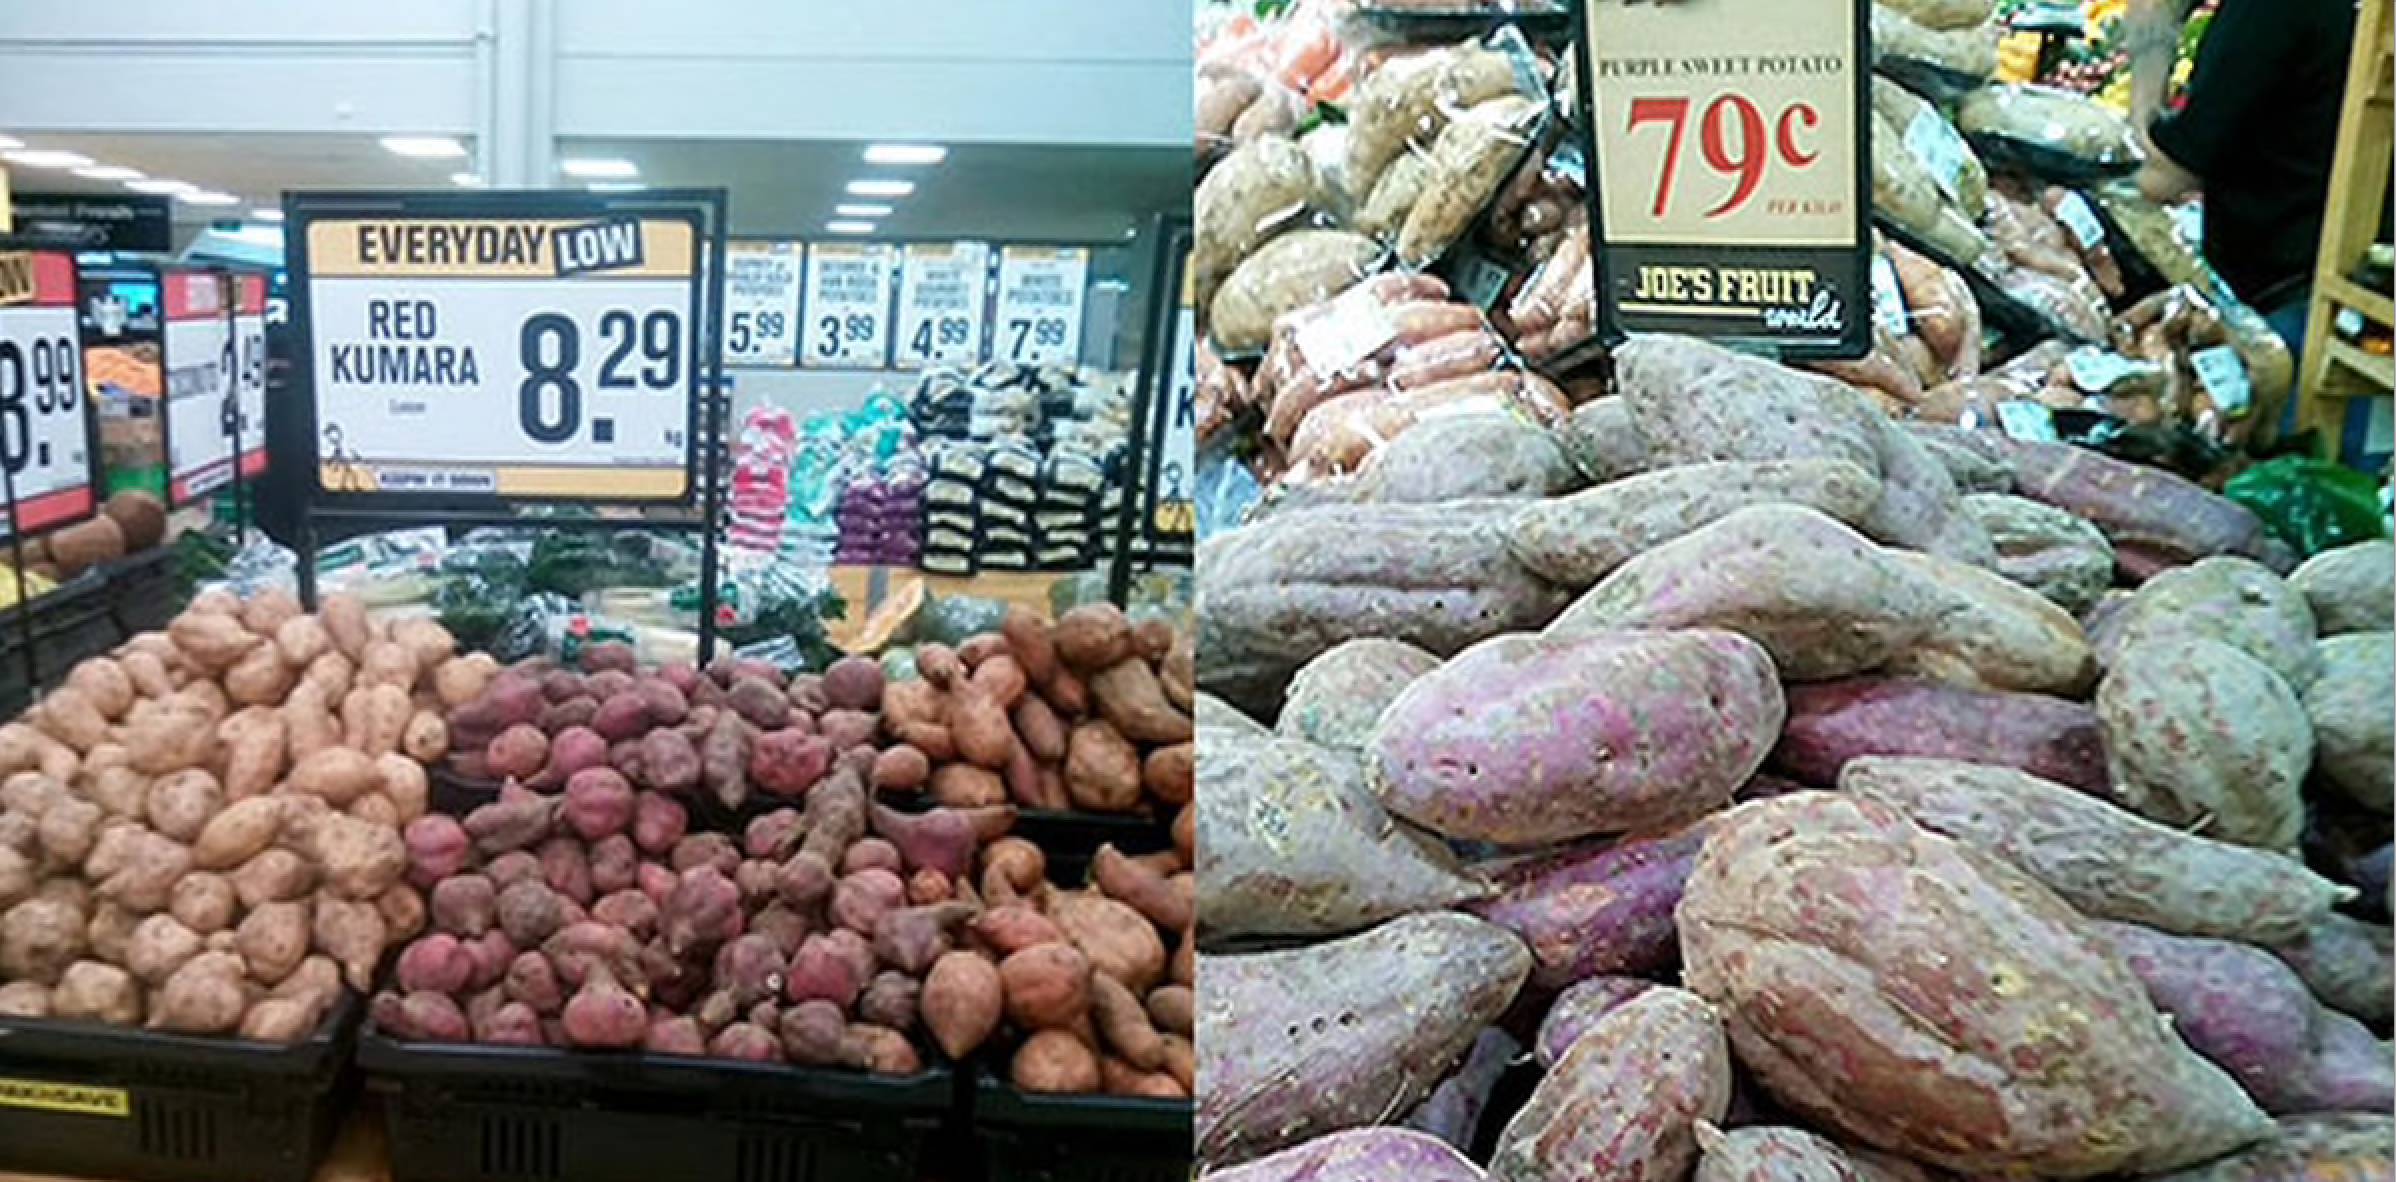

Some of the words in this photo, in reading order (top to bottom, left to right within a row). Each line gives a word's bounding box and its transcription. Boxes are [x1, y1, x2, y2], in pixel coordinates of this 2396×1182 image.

[1600, 58, 1672, 77] PURPLE
[1680, 57, 1749, 75] SWEET
[1757, 56, 1842, 74] POTATO
[357, 224, 547, 265] EVERYDAY
[559, 222, 636, 274] LOW
[1635, 267, 1711, 300] JOE'S
[1719, 270, 1815, 303] FRUIT
[369, 300, 436, 339] RED
[729, 312, 785, 352] 5.99
[818, 314, 875, 356] 3.99
[911, 317, 968, 358] 4.99
[1009, 317, 1067, 359] 7.99
[331, 345, 479, 386] KUMARA
[519, 310, 681, 444] 8.29
